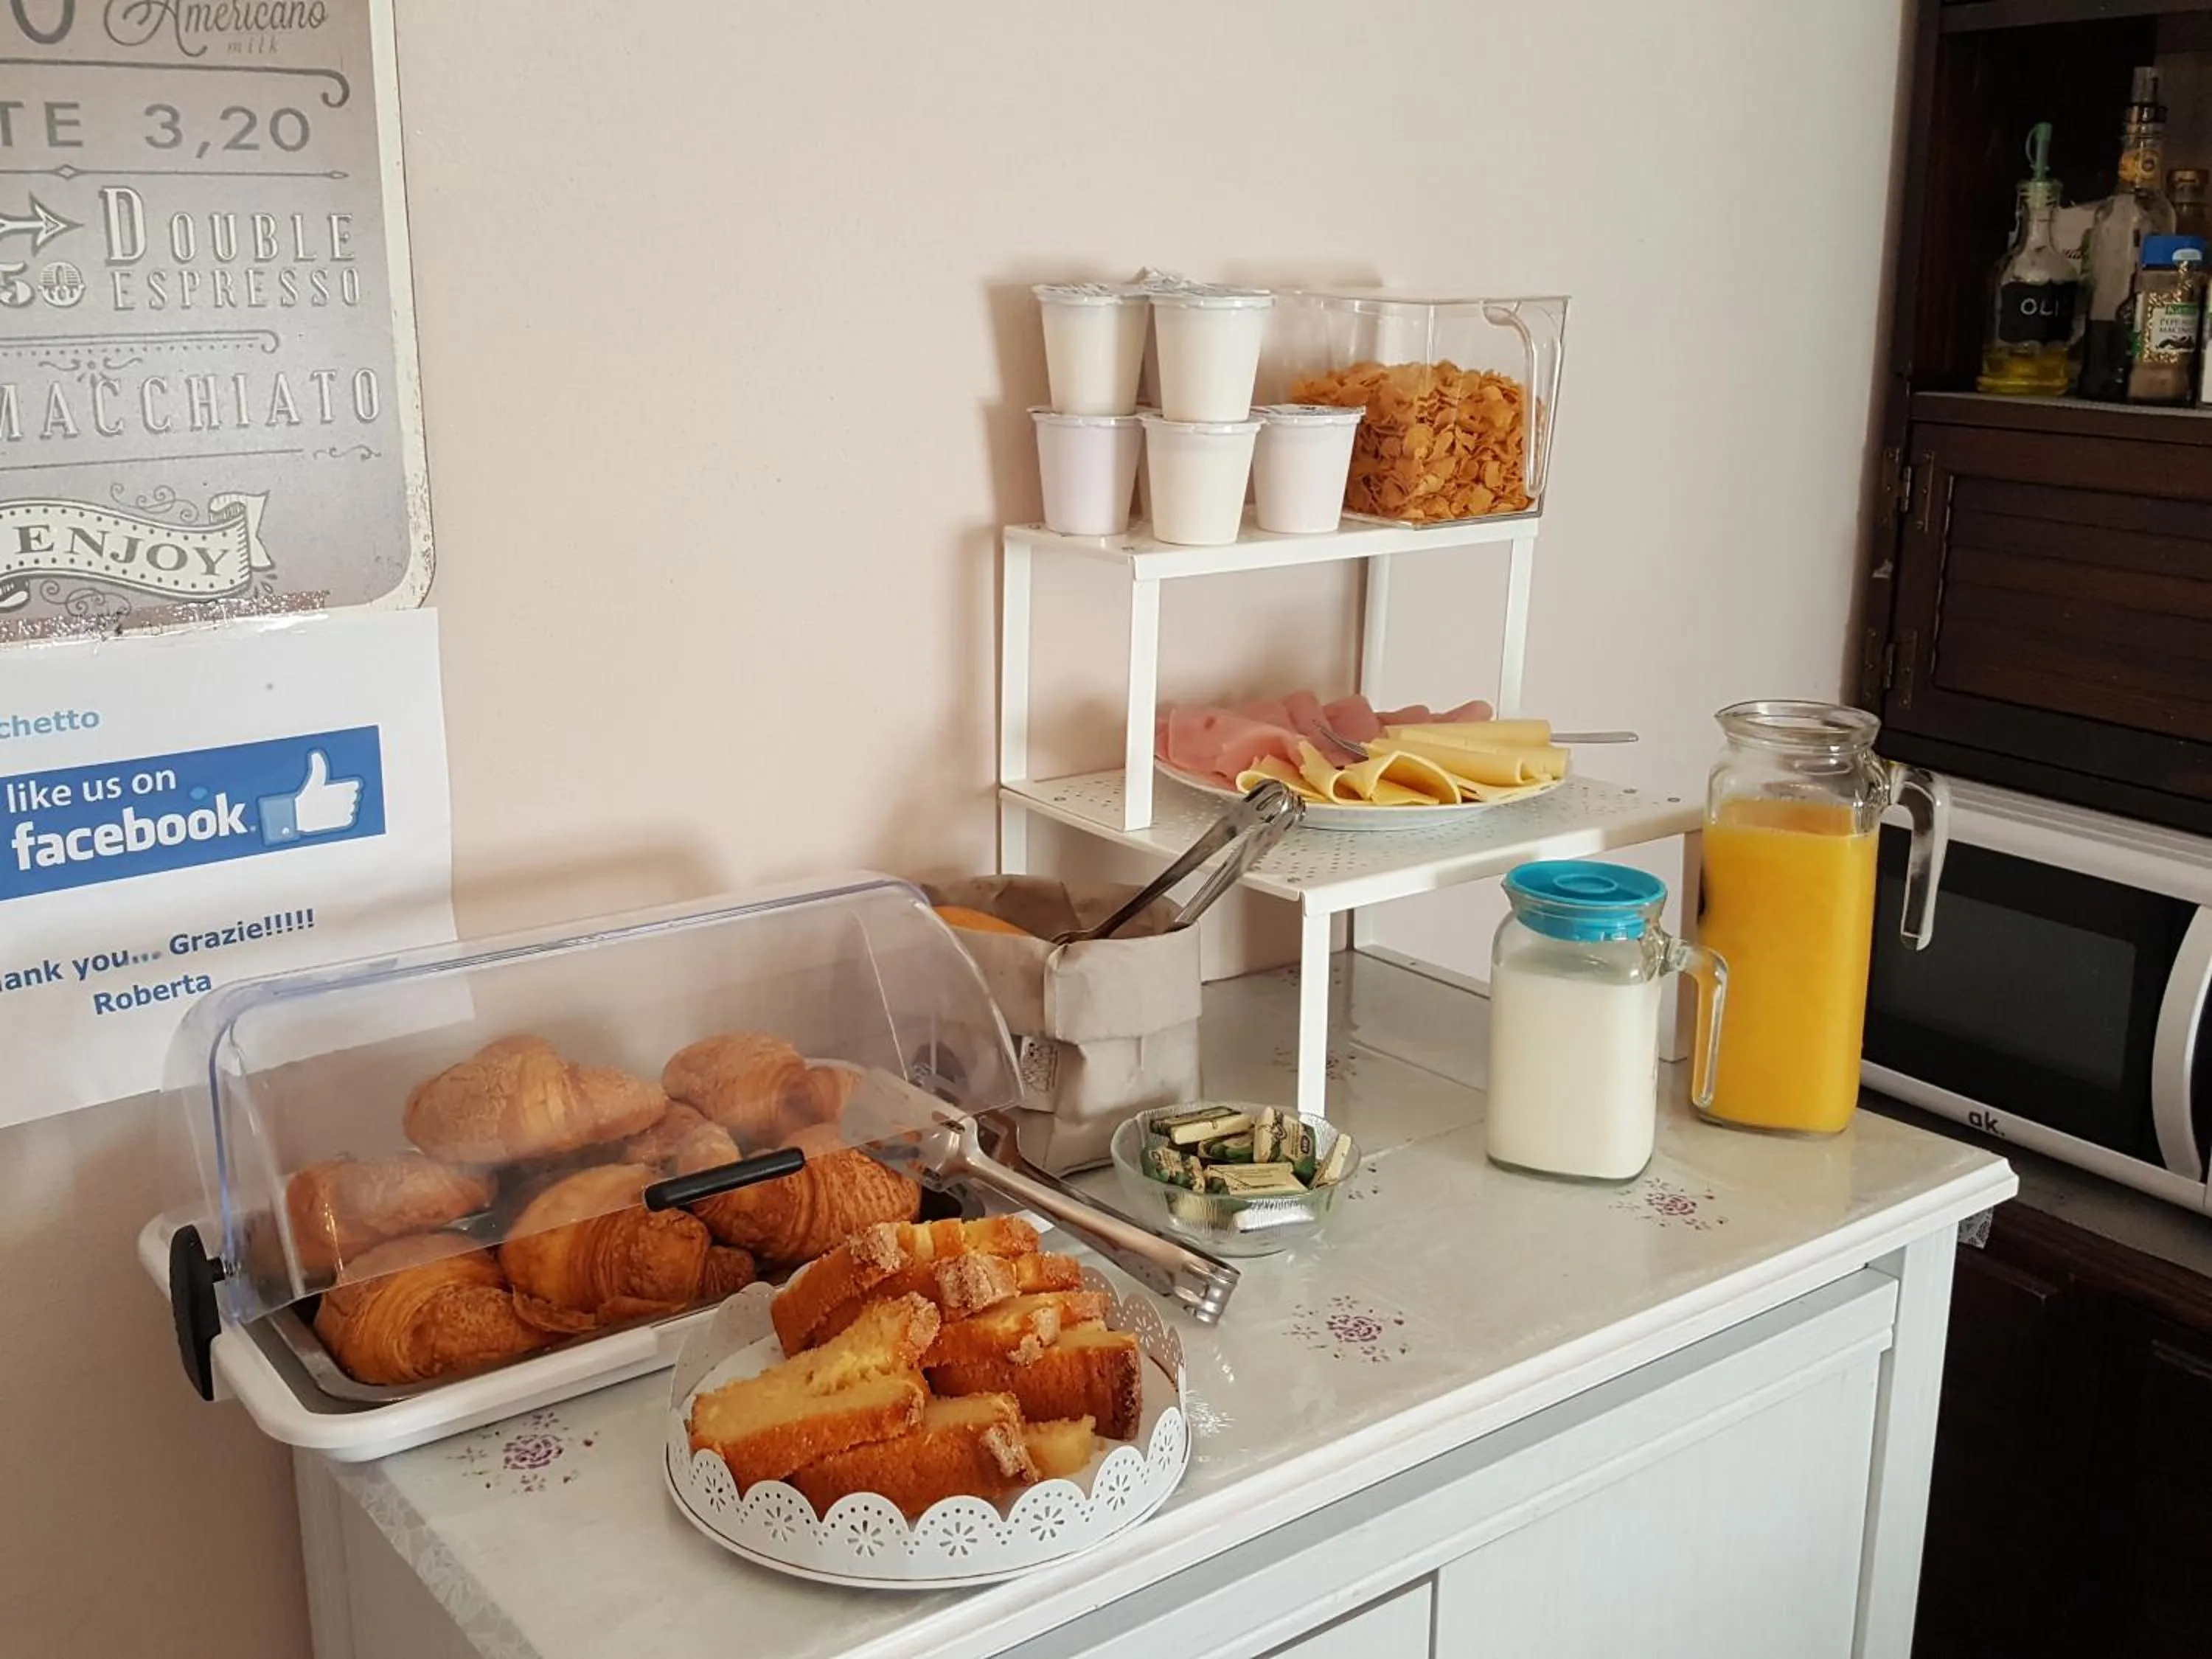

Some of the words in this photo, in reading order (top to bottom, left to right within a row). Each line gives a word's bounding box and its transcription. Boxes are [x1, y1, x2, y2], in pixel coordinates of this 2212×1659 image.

[144, 103, 310, 159] 3,20
[112, 266, 361, 310] ESPRESSO
[14, 524, 229, 577] ENJOY
[7, 783, 72, 813] like
[83, 776, 121, 801] us
[132, 768, 176, 795] on
[93, 974, 212, 1015] Roberta
